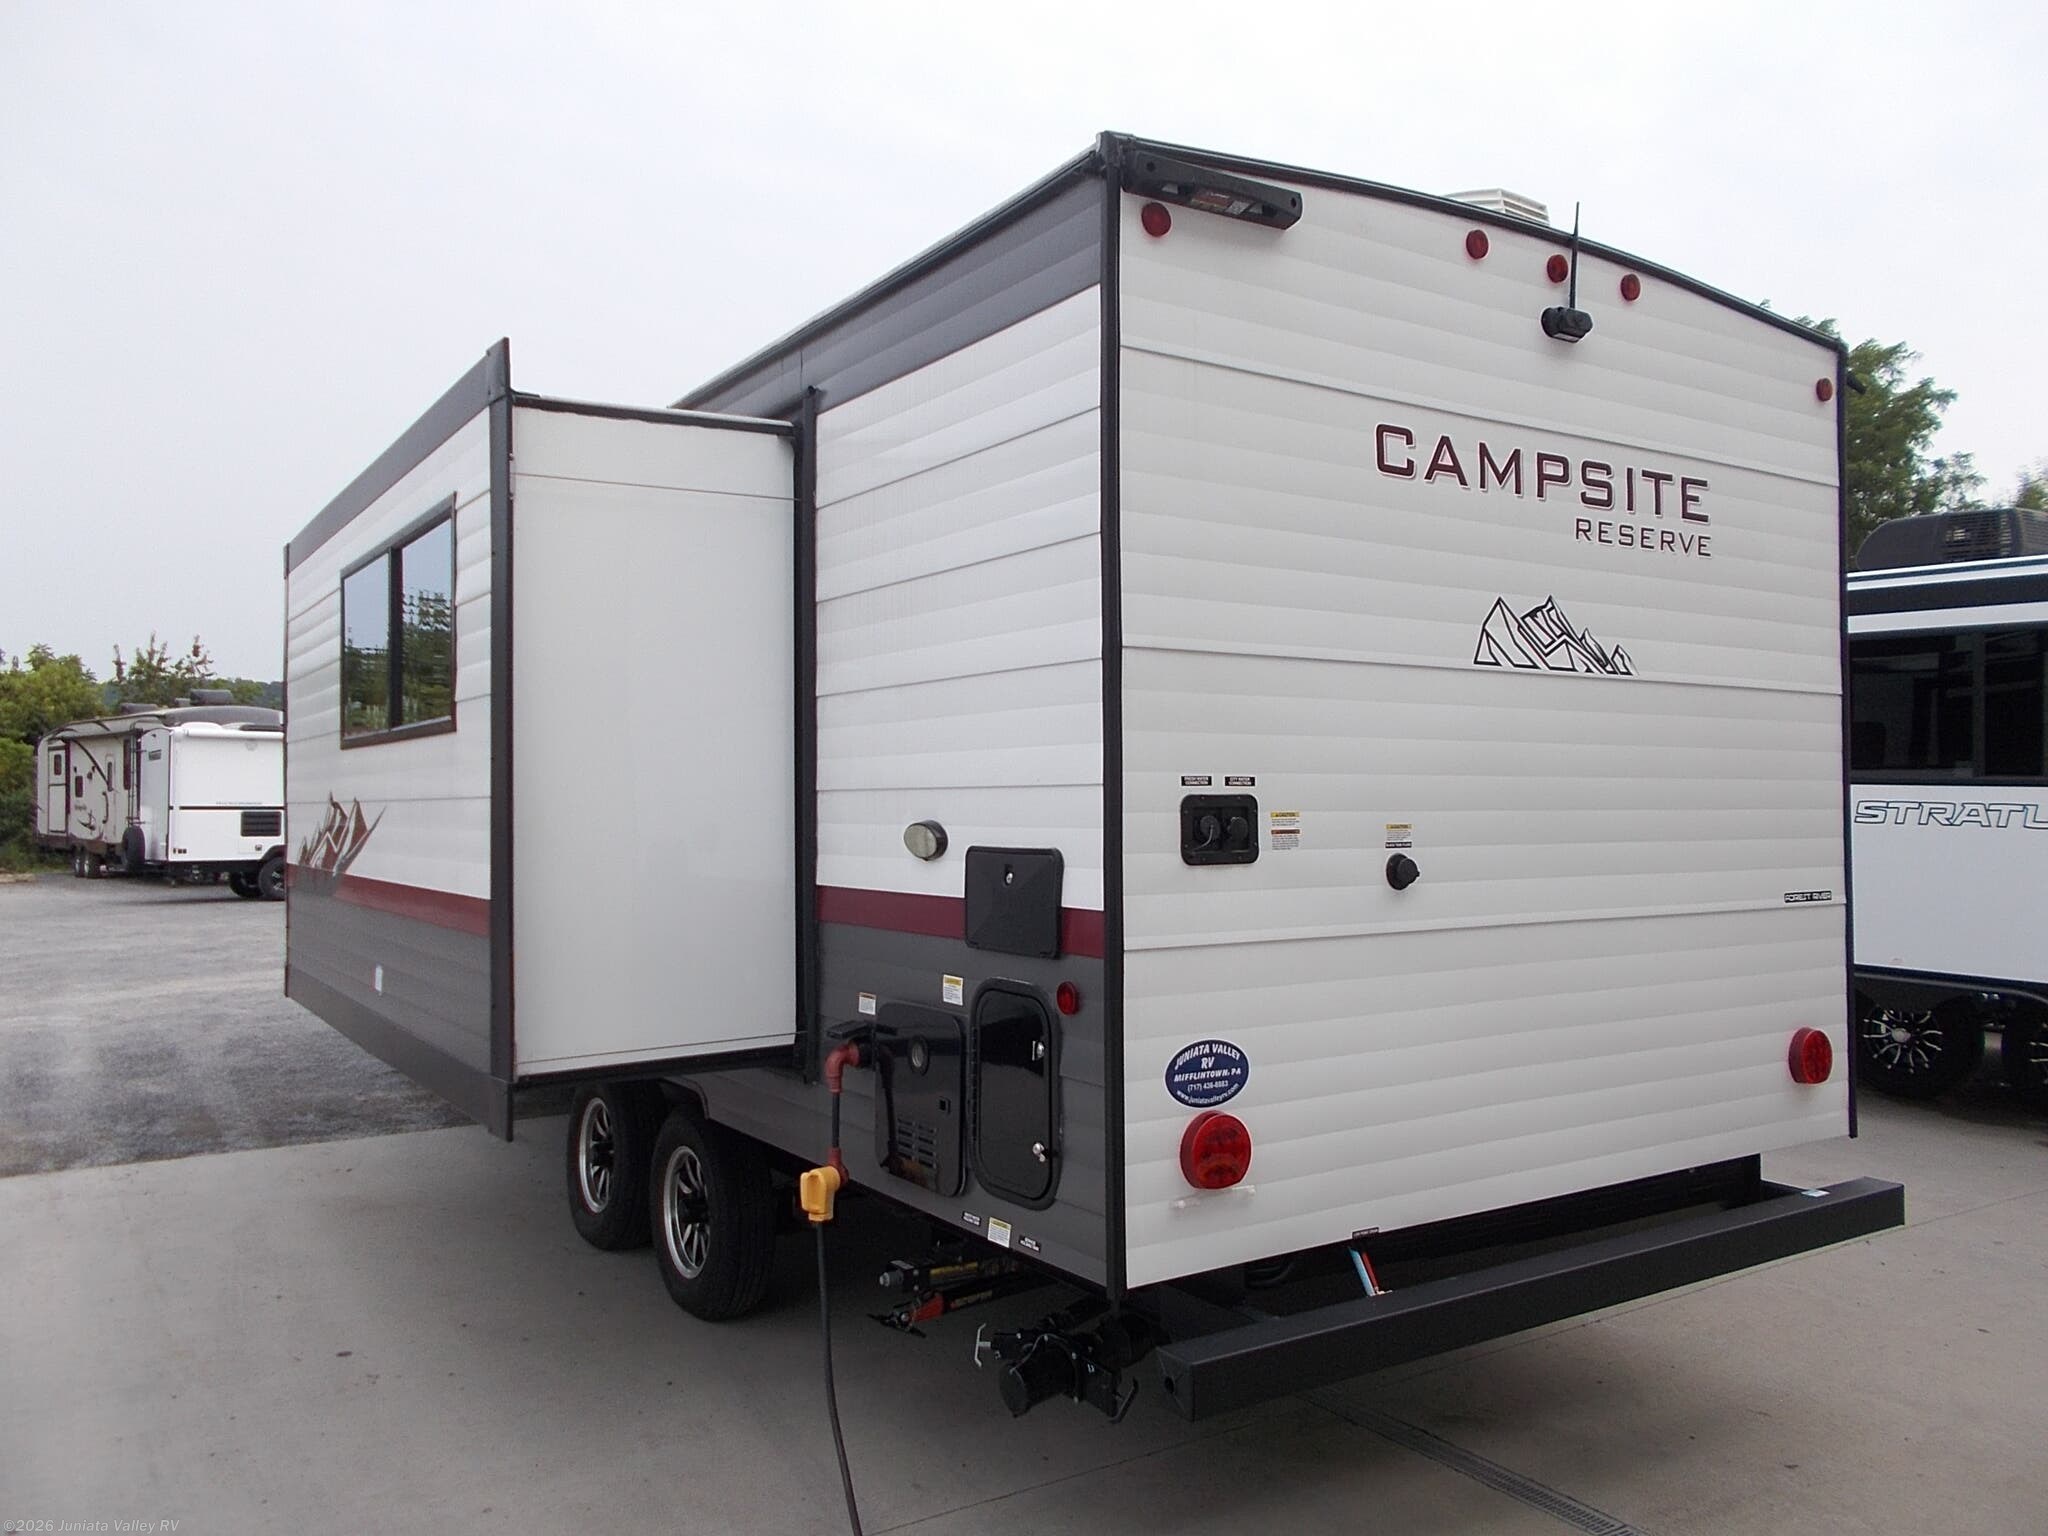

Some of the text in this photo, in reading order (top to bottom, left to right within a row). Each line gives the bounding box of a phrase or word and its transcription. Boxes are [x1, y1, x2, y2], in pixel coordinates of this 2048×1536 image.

[1375, 423, 1710, 523] CAMPSITE
[1575, 517, 1712, 557] RESERVE
[1174, 1043, 1240, 1070] JUNIATA VALLEY
[1201, 1056, 1215, 1069] RV
[1231, 1067, 1241, 1075] PA
[1187, 1083, 1202, 1093] (717)
